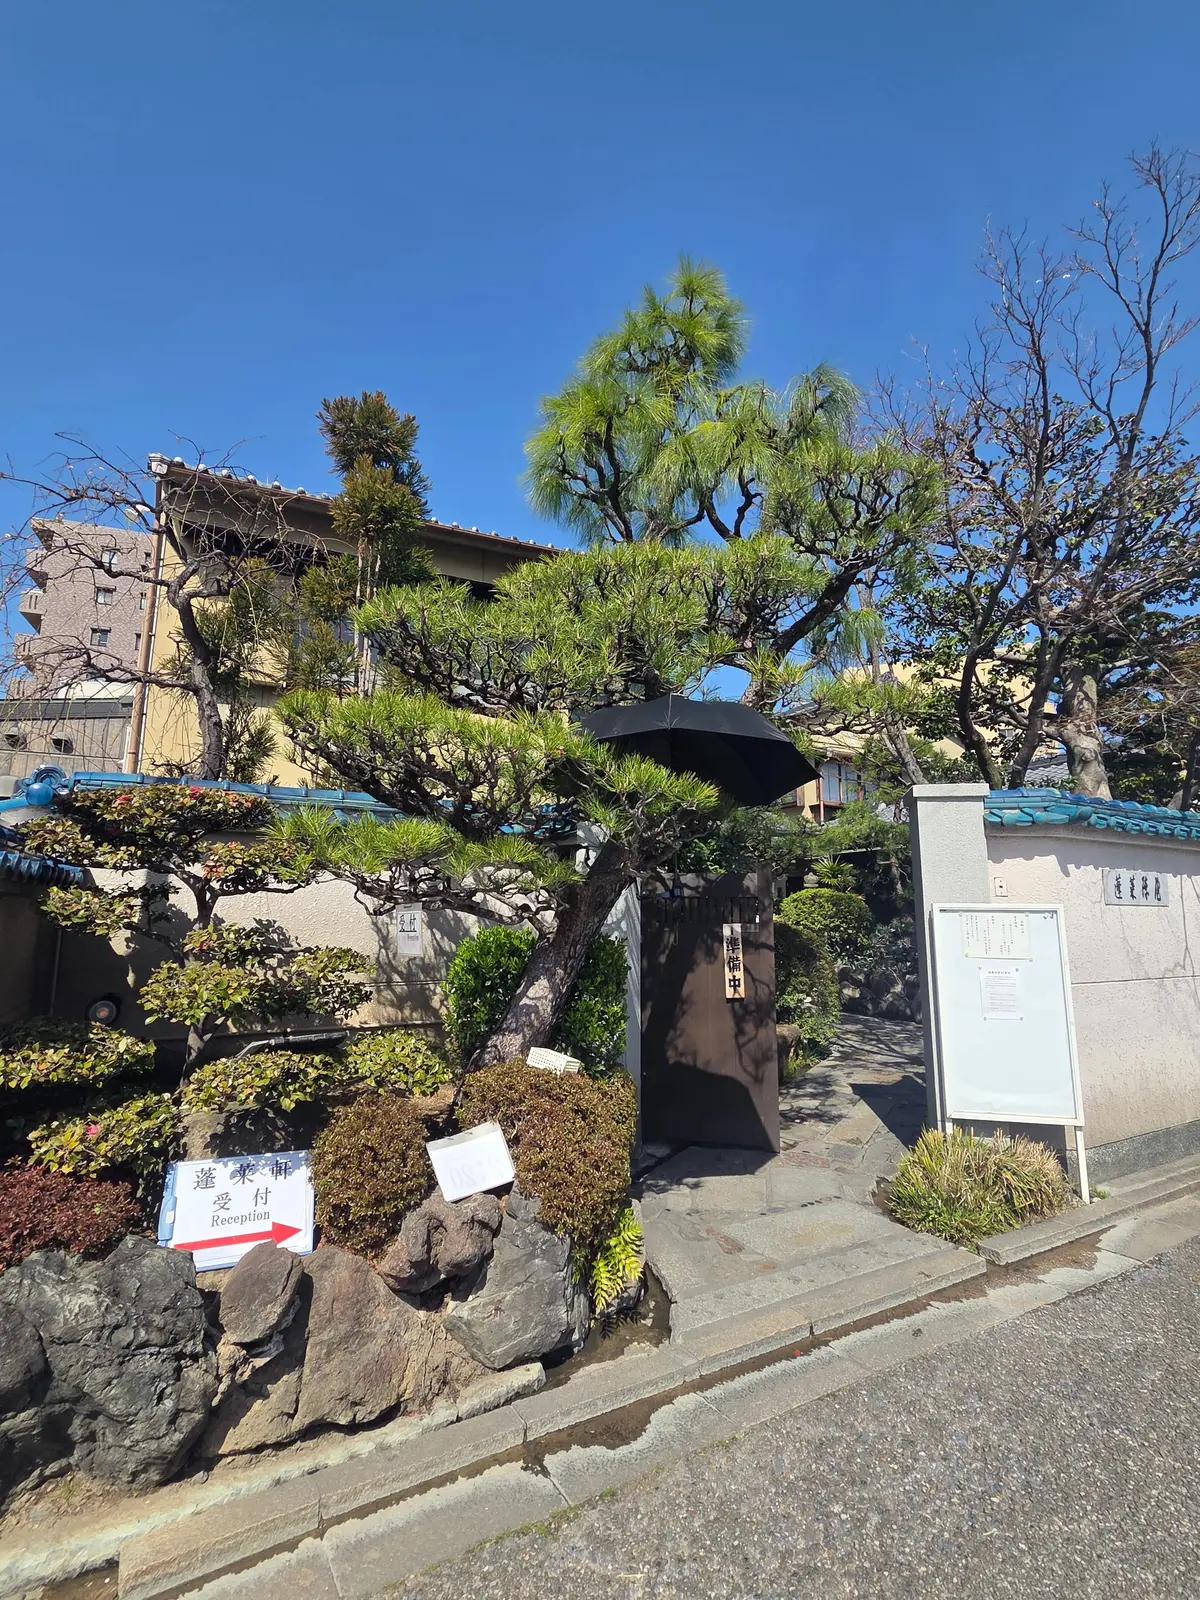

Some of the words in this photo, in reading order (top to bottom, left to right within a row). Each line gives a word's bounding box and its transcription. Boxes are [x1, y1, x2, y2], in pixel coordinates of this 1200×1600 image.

[725, 936, 741, 994] 準備中
[193, 1159, 292, 1190] 蓬莱軒
[212, 1187, 272, 1213] 受付
[210, 1210, 271, 1228] Reception
